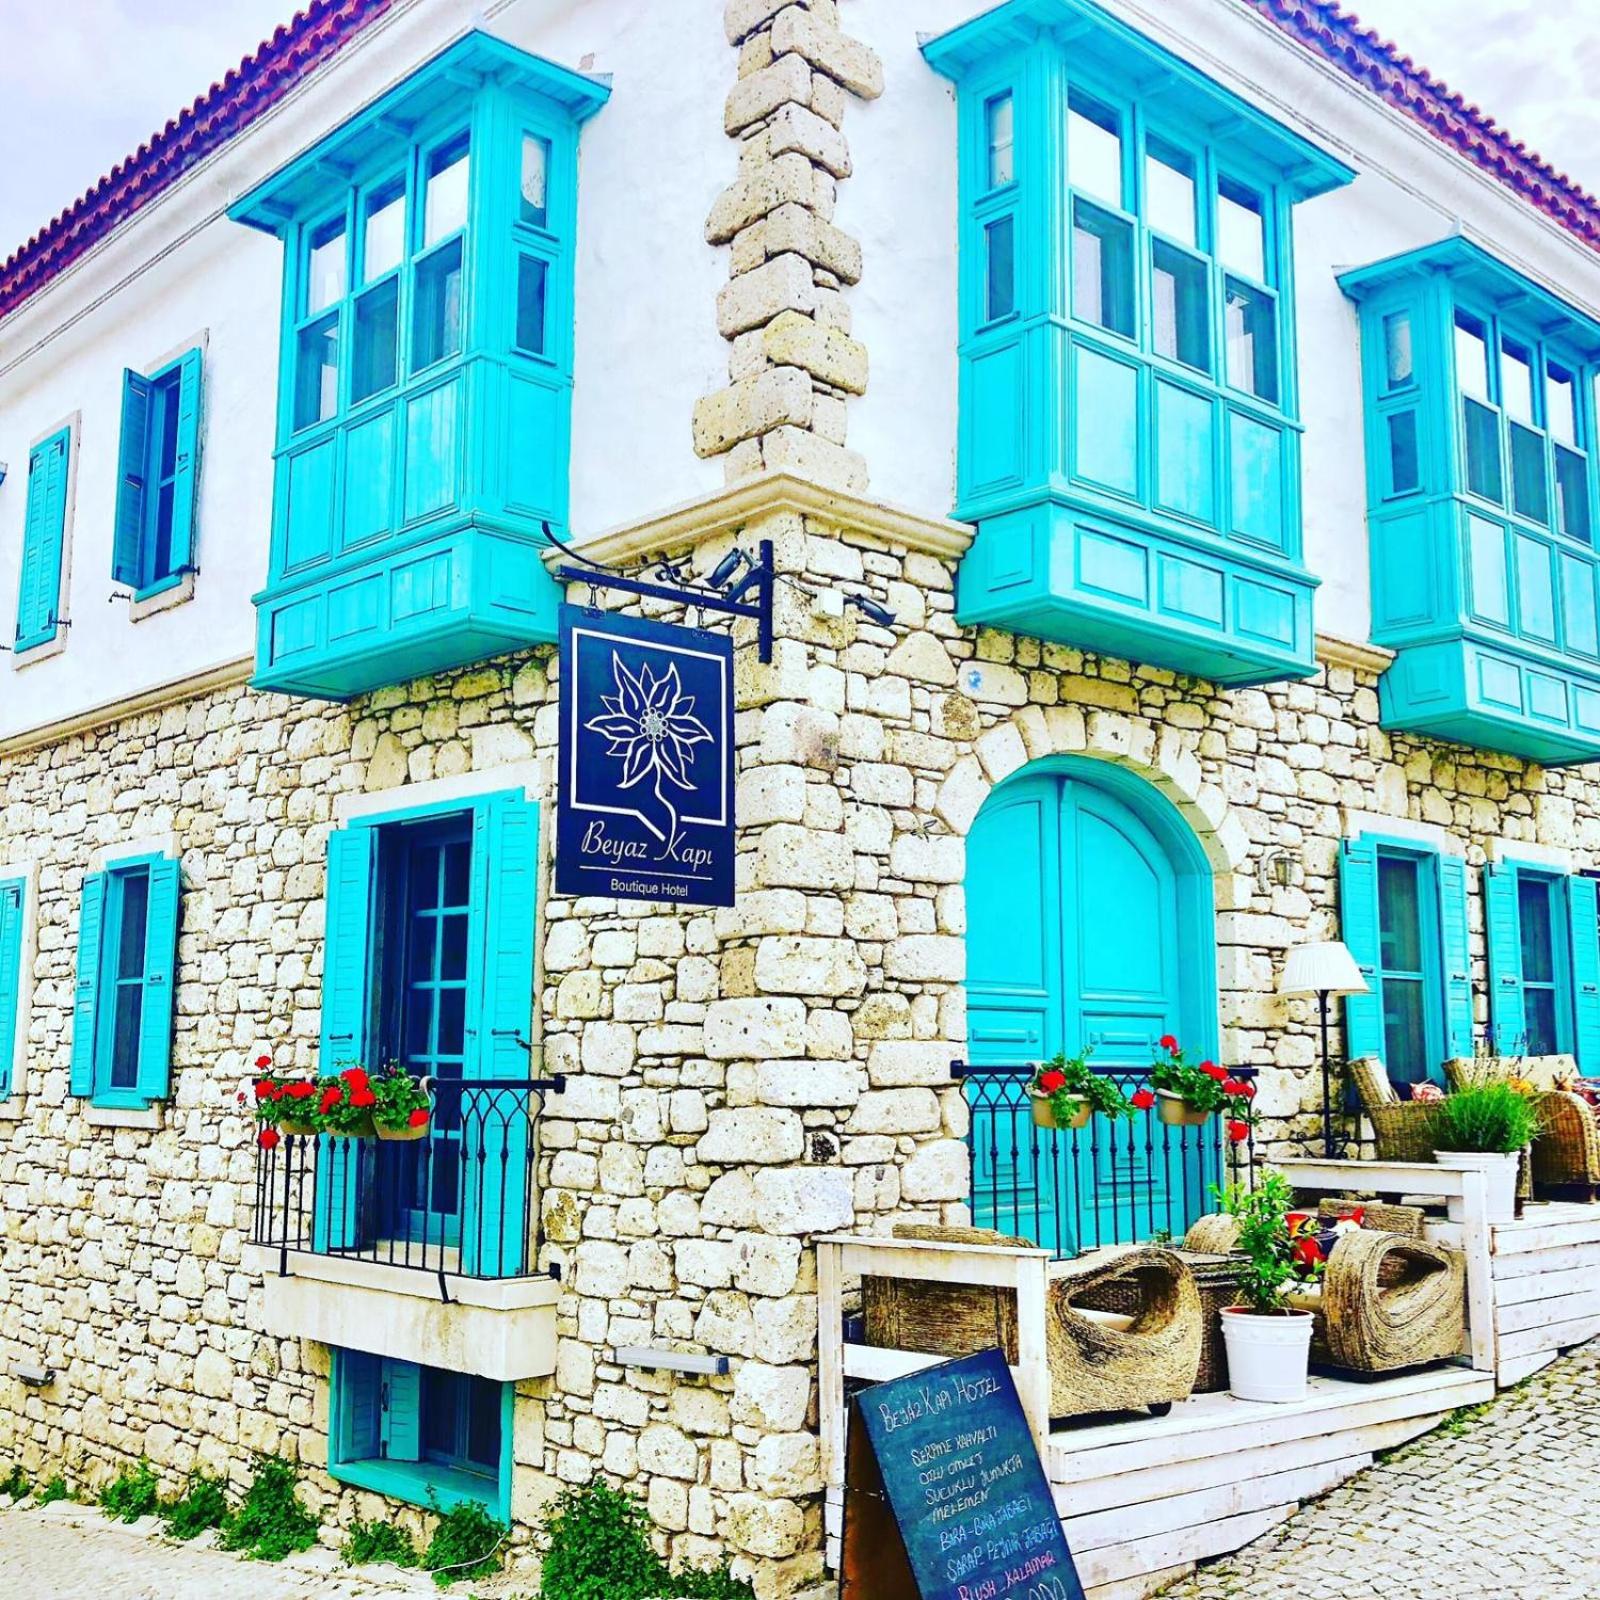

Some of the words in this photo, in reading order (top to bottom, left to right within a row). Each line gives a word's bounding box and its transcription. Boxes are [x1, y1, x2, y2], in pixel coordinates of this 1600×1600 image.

[581, 820, 648, 864] Beyaz
[654, 830, 713, 872] Kapı
[610, 878, 659, 895] Boutique
[661, 883, 688, 897] Hotel
[952, 1377, 1001, 1404] HOTEL
[947, 1452, 984, 1475] OMLET
[925, 1475, 975, 1505] SUCUKLU
[1005, 1550, 1056, 1589] KALAMAR
